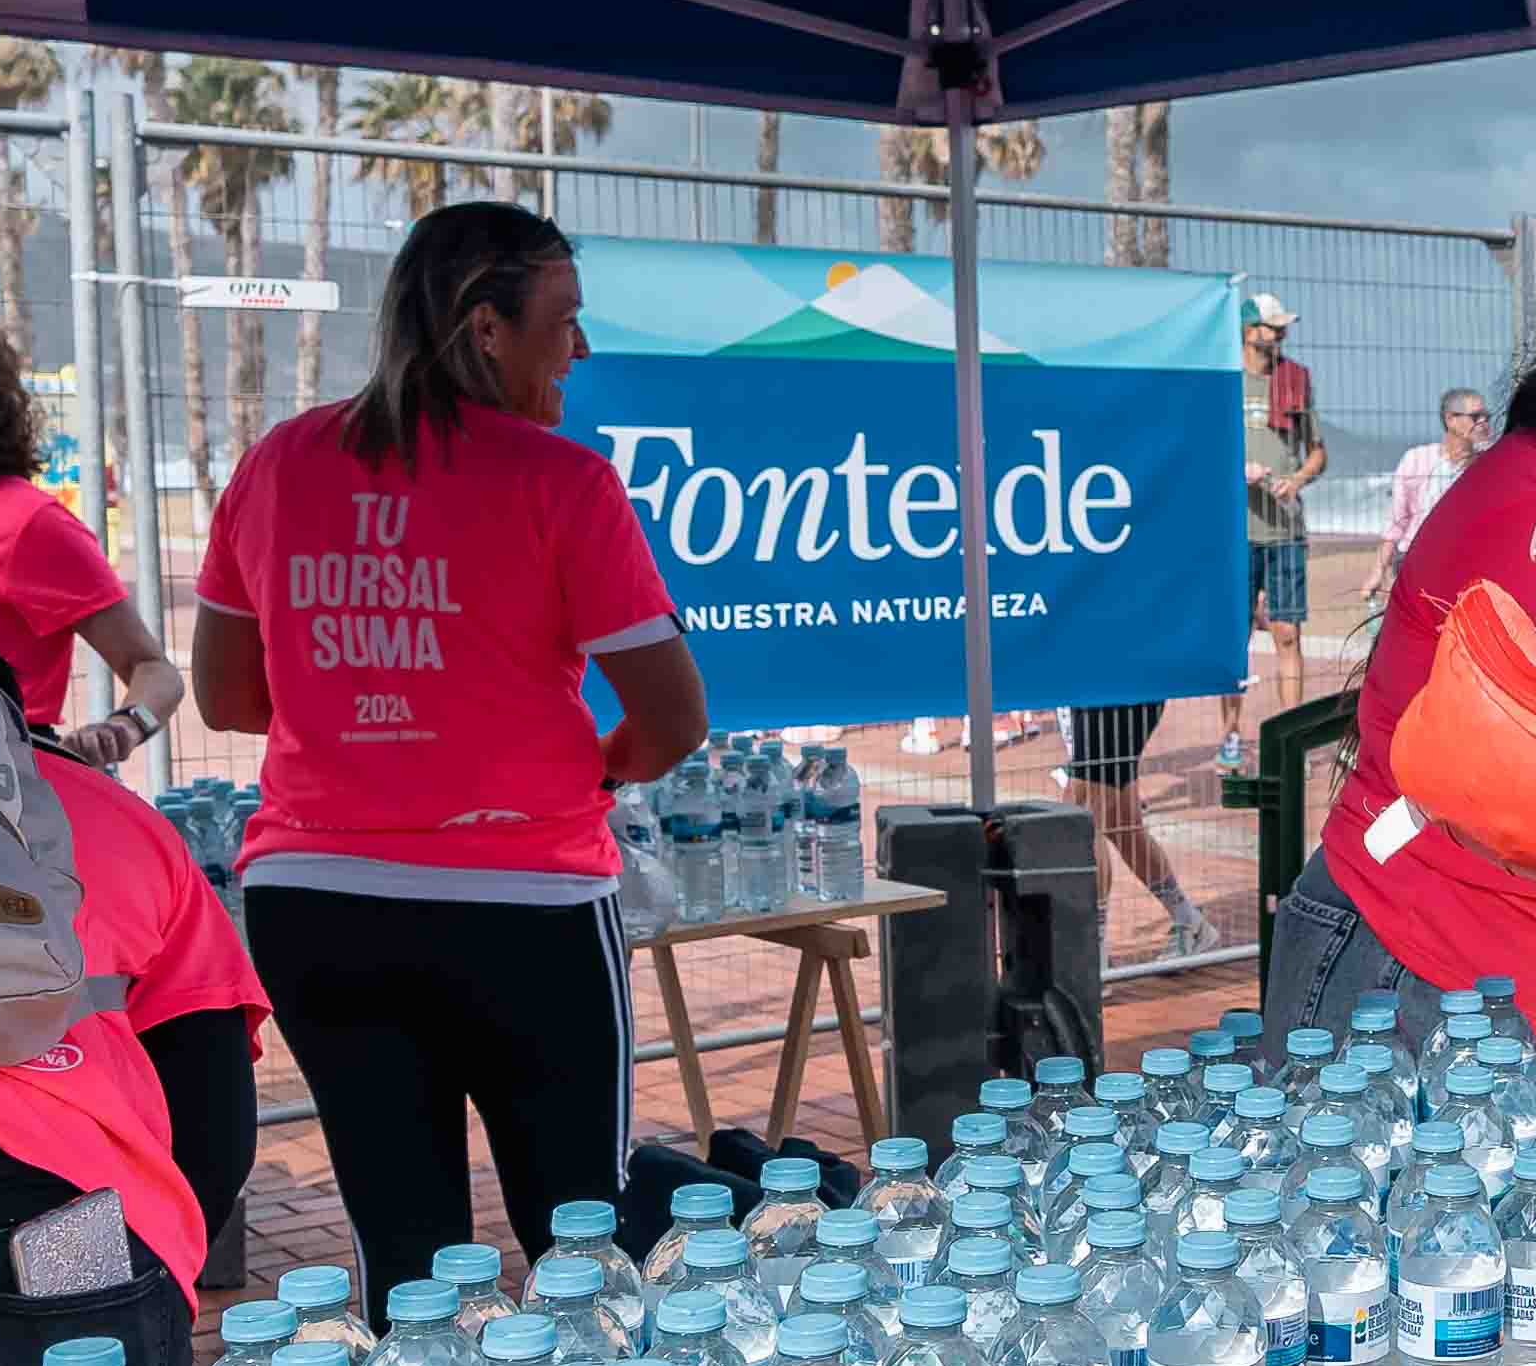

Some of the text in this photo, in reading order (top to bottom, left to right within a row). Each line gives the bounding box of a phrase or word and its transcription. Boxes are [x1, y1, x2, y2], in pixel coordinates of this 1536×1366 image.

[352, 492, 409, 547] TU
[597, 423, 1132, 566] Fontede
[289, 553, 462, 614] DORSAL
[686, 592, 1048, 633] NUESTRA NATURAEZA
[312, 614, 444, 671] SUMA
[354, 694, 414, 724] 2024
